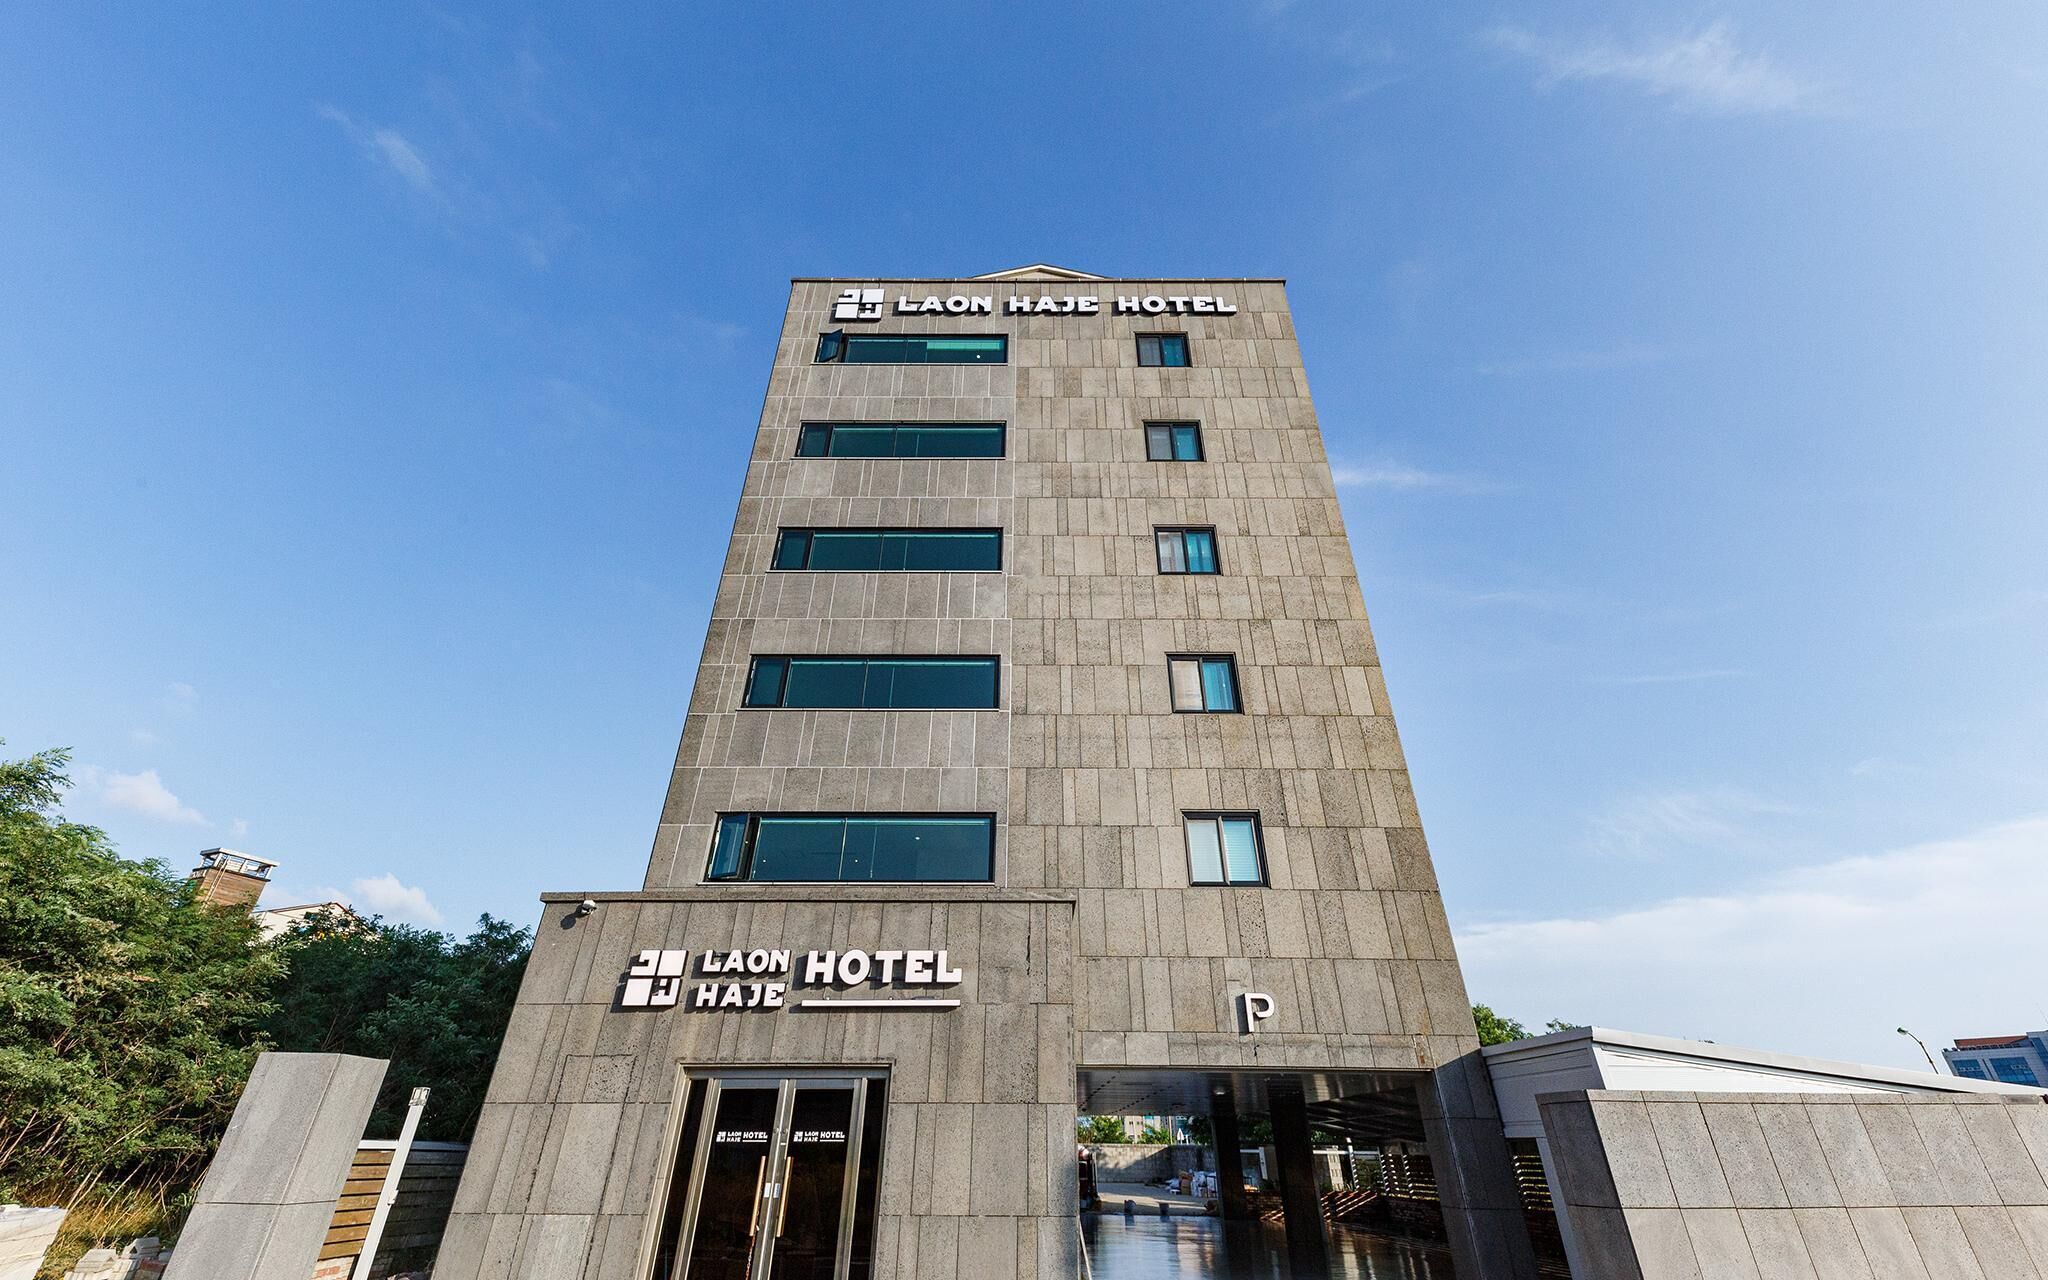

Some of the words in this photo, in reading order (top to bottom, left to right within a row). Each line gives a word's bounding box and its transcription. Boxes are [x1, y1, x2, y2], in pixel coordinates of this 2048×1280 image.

[897, 296, 992, 313] LAON
[1008, 296, 1099, 313] HAJE
[1117, 296, 1238, 314] HOTEL
[702, 949, 791, 973] LAON
[804, 950, 962, 985] HOTEL
[695, 983, 786, 1007] HAJE
[1244, 993, 1275, 1033] P
[743, 1131, 768, 1139] HOTEL
[820, 1131, 845, 1139] HOTEL
